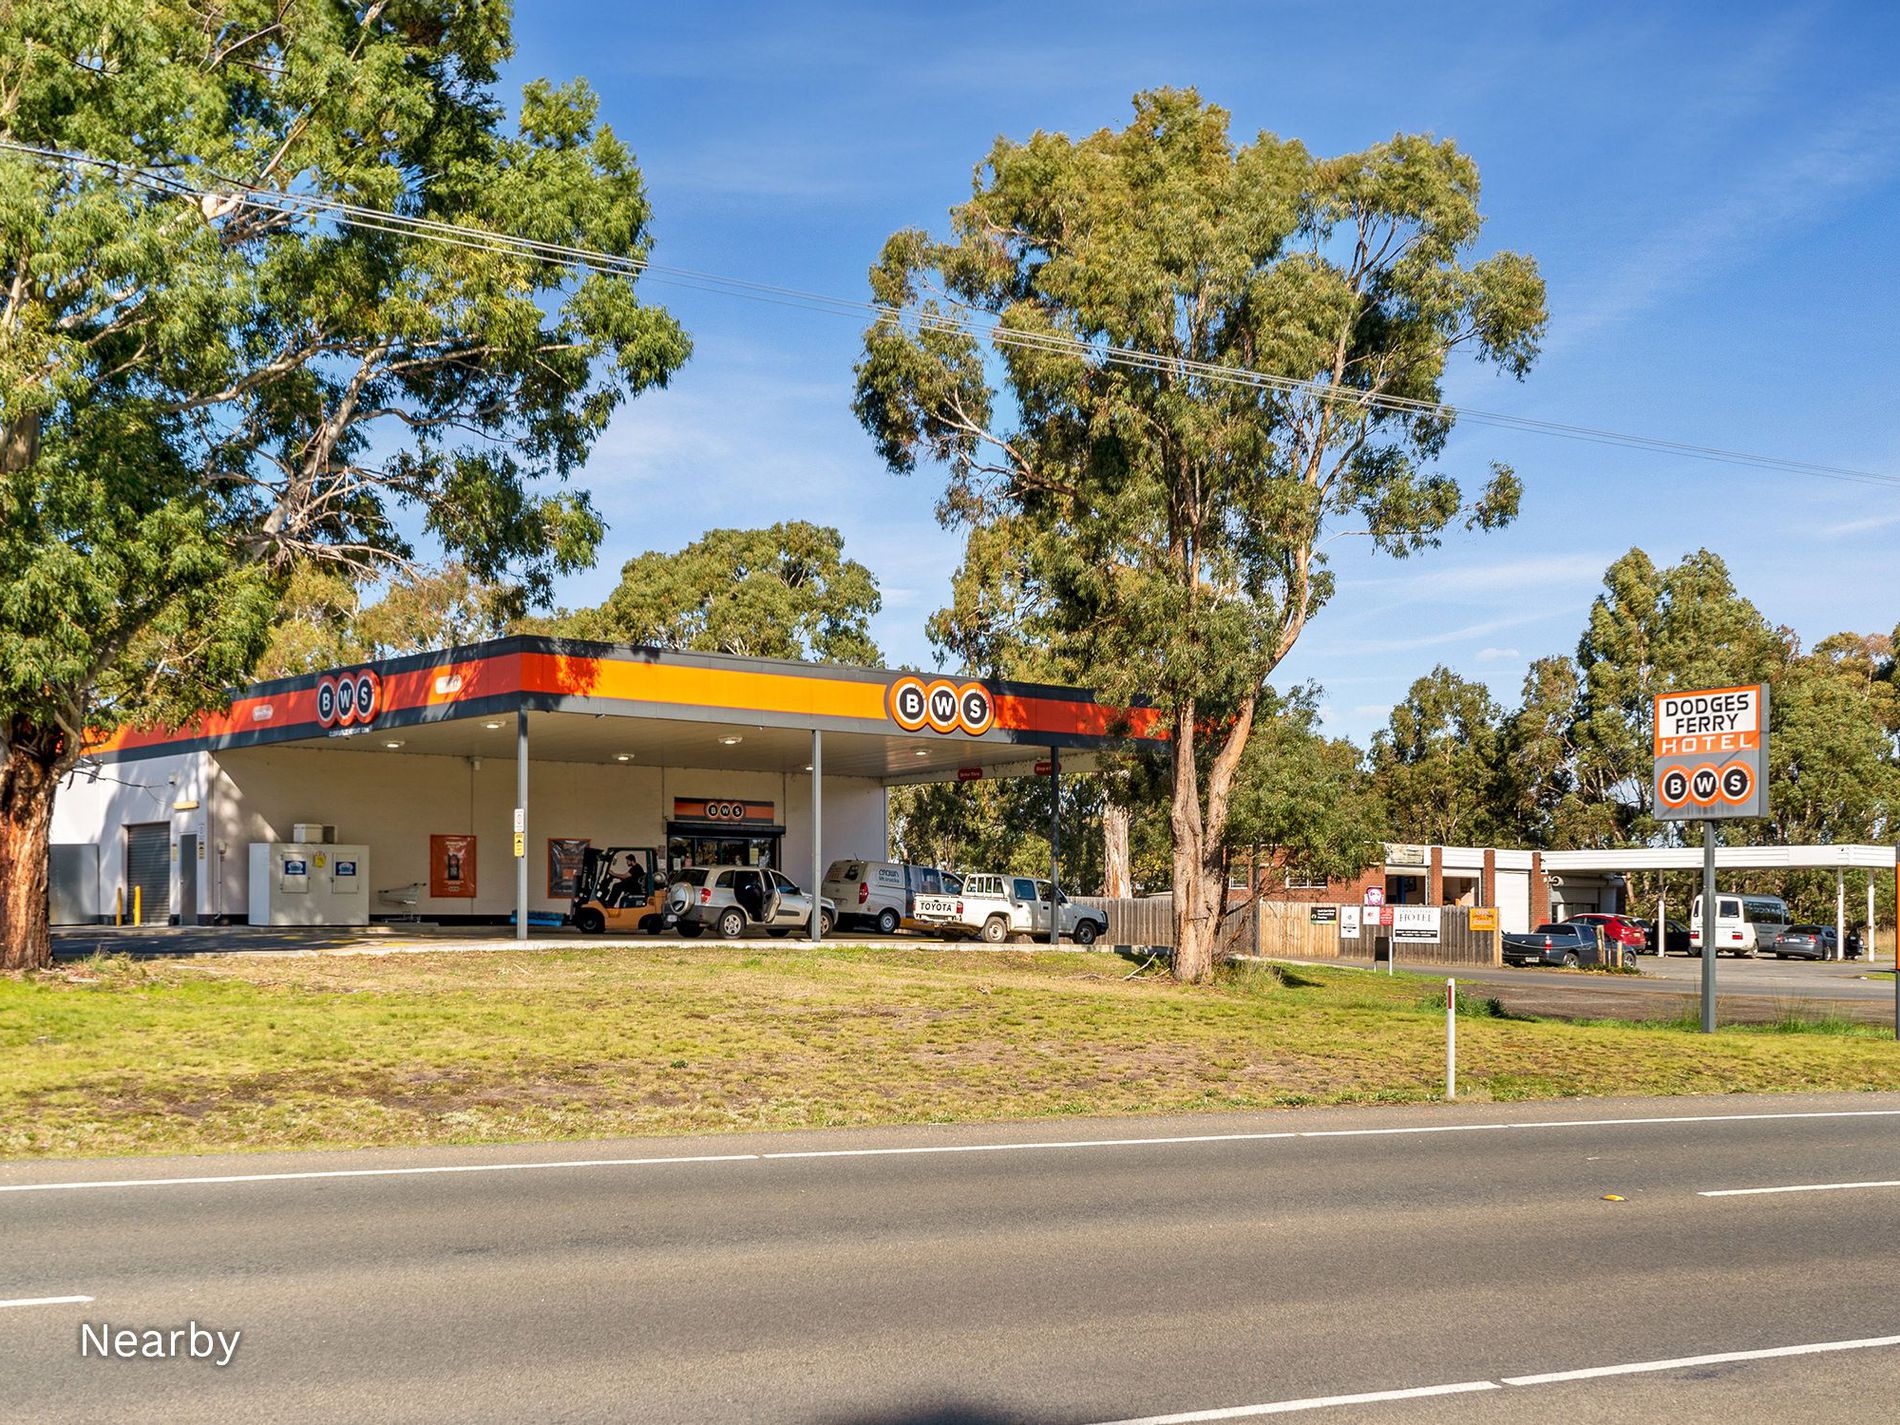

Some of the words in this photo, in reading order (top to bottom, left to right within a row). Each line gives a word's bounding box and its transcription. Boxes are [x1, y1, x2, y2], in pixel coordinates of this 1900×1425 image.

[322, 686, 368, 712] BWS
[906, 694, 981, 719] BWS
[1666, 694, 1749, 717] DODGES
[1675, 713, 1739, 734] FERRY
[1661, 734, 1752, 754] HOTEL
[1670, 775, 1741, 795] BWS
[920, 902, 952, 912] TOYOTA
